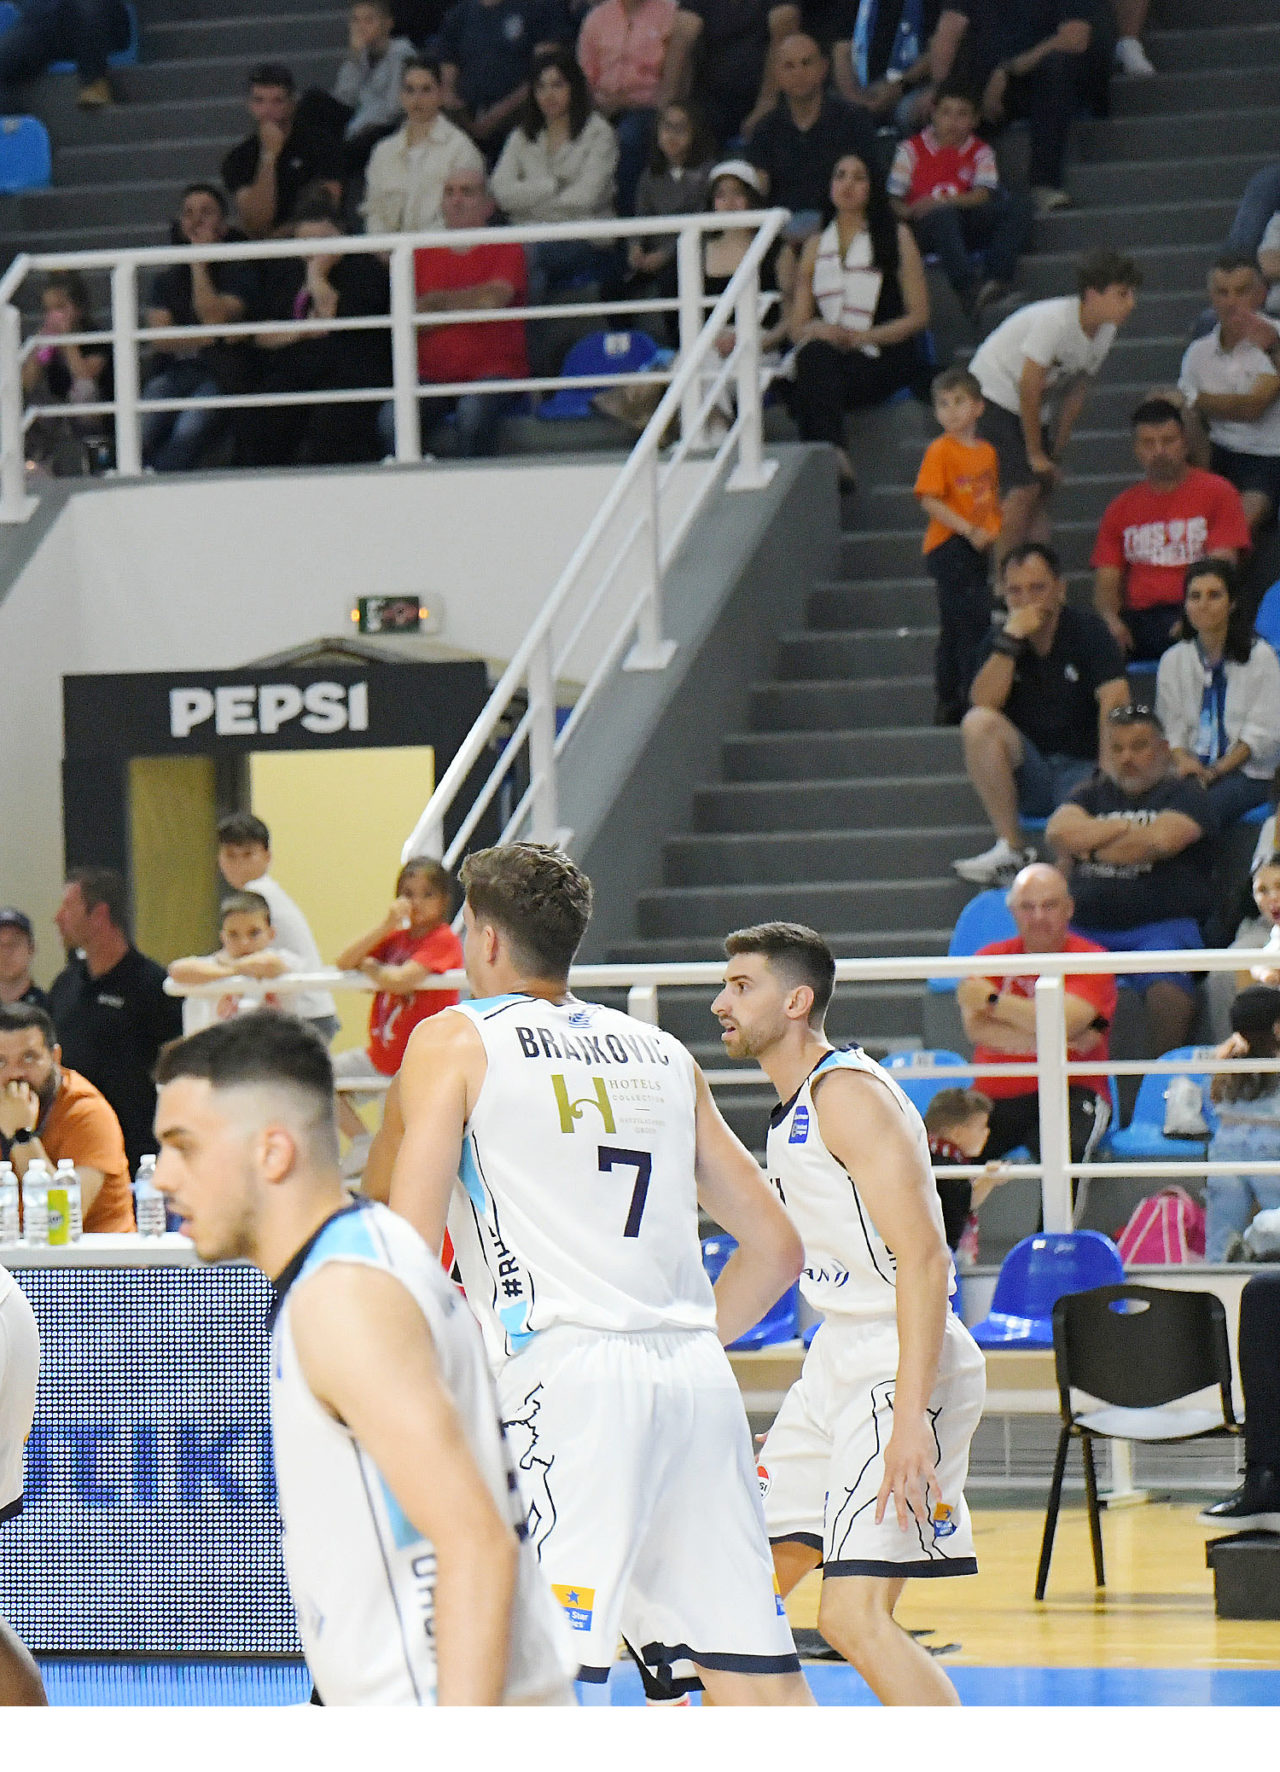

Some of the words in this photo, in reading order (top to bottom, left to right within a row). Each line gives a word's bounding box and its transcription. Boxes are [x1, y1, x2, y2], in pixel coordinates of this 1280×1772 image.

[170, 681, 369, 738] PEPSI
[608, 1079, 662, 1091] HOTELS
[597, 1145, 653, 1239] 7
